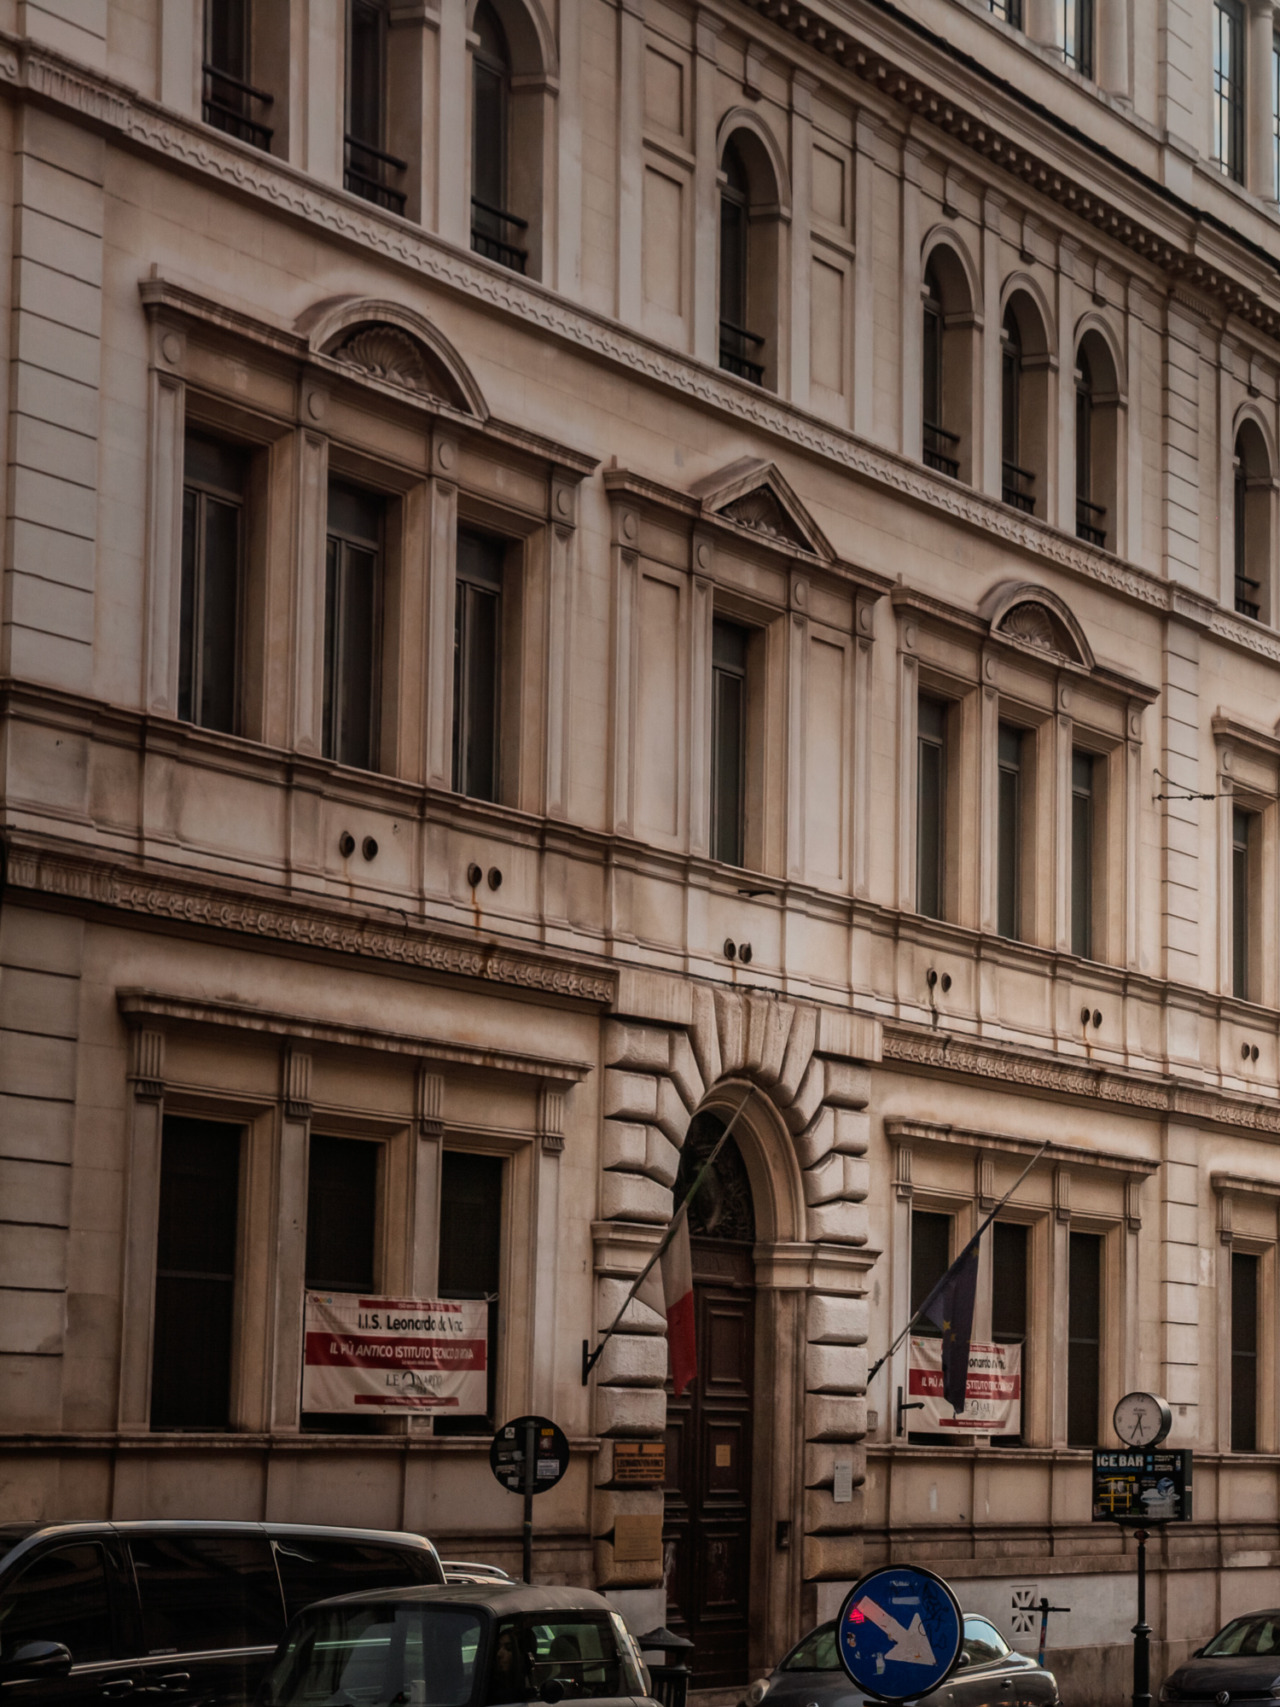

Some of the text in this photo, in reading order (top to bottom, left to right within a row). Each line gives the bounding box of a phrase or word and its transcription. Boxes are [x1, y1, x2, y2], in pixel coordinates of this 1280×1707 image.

[387, 1315, 436, 1331] Leonardo
[355, 1345, 393, 1358] ANTICO
[395, 1346, 430, 1359] ISTITUTO
[1096, 1454, 1144, 1467] ICE BAR
